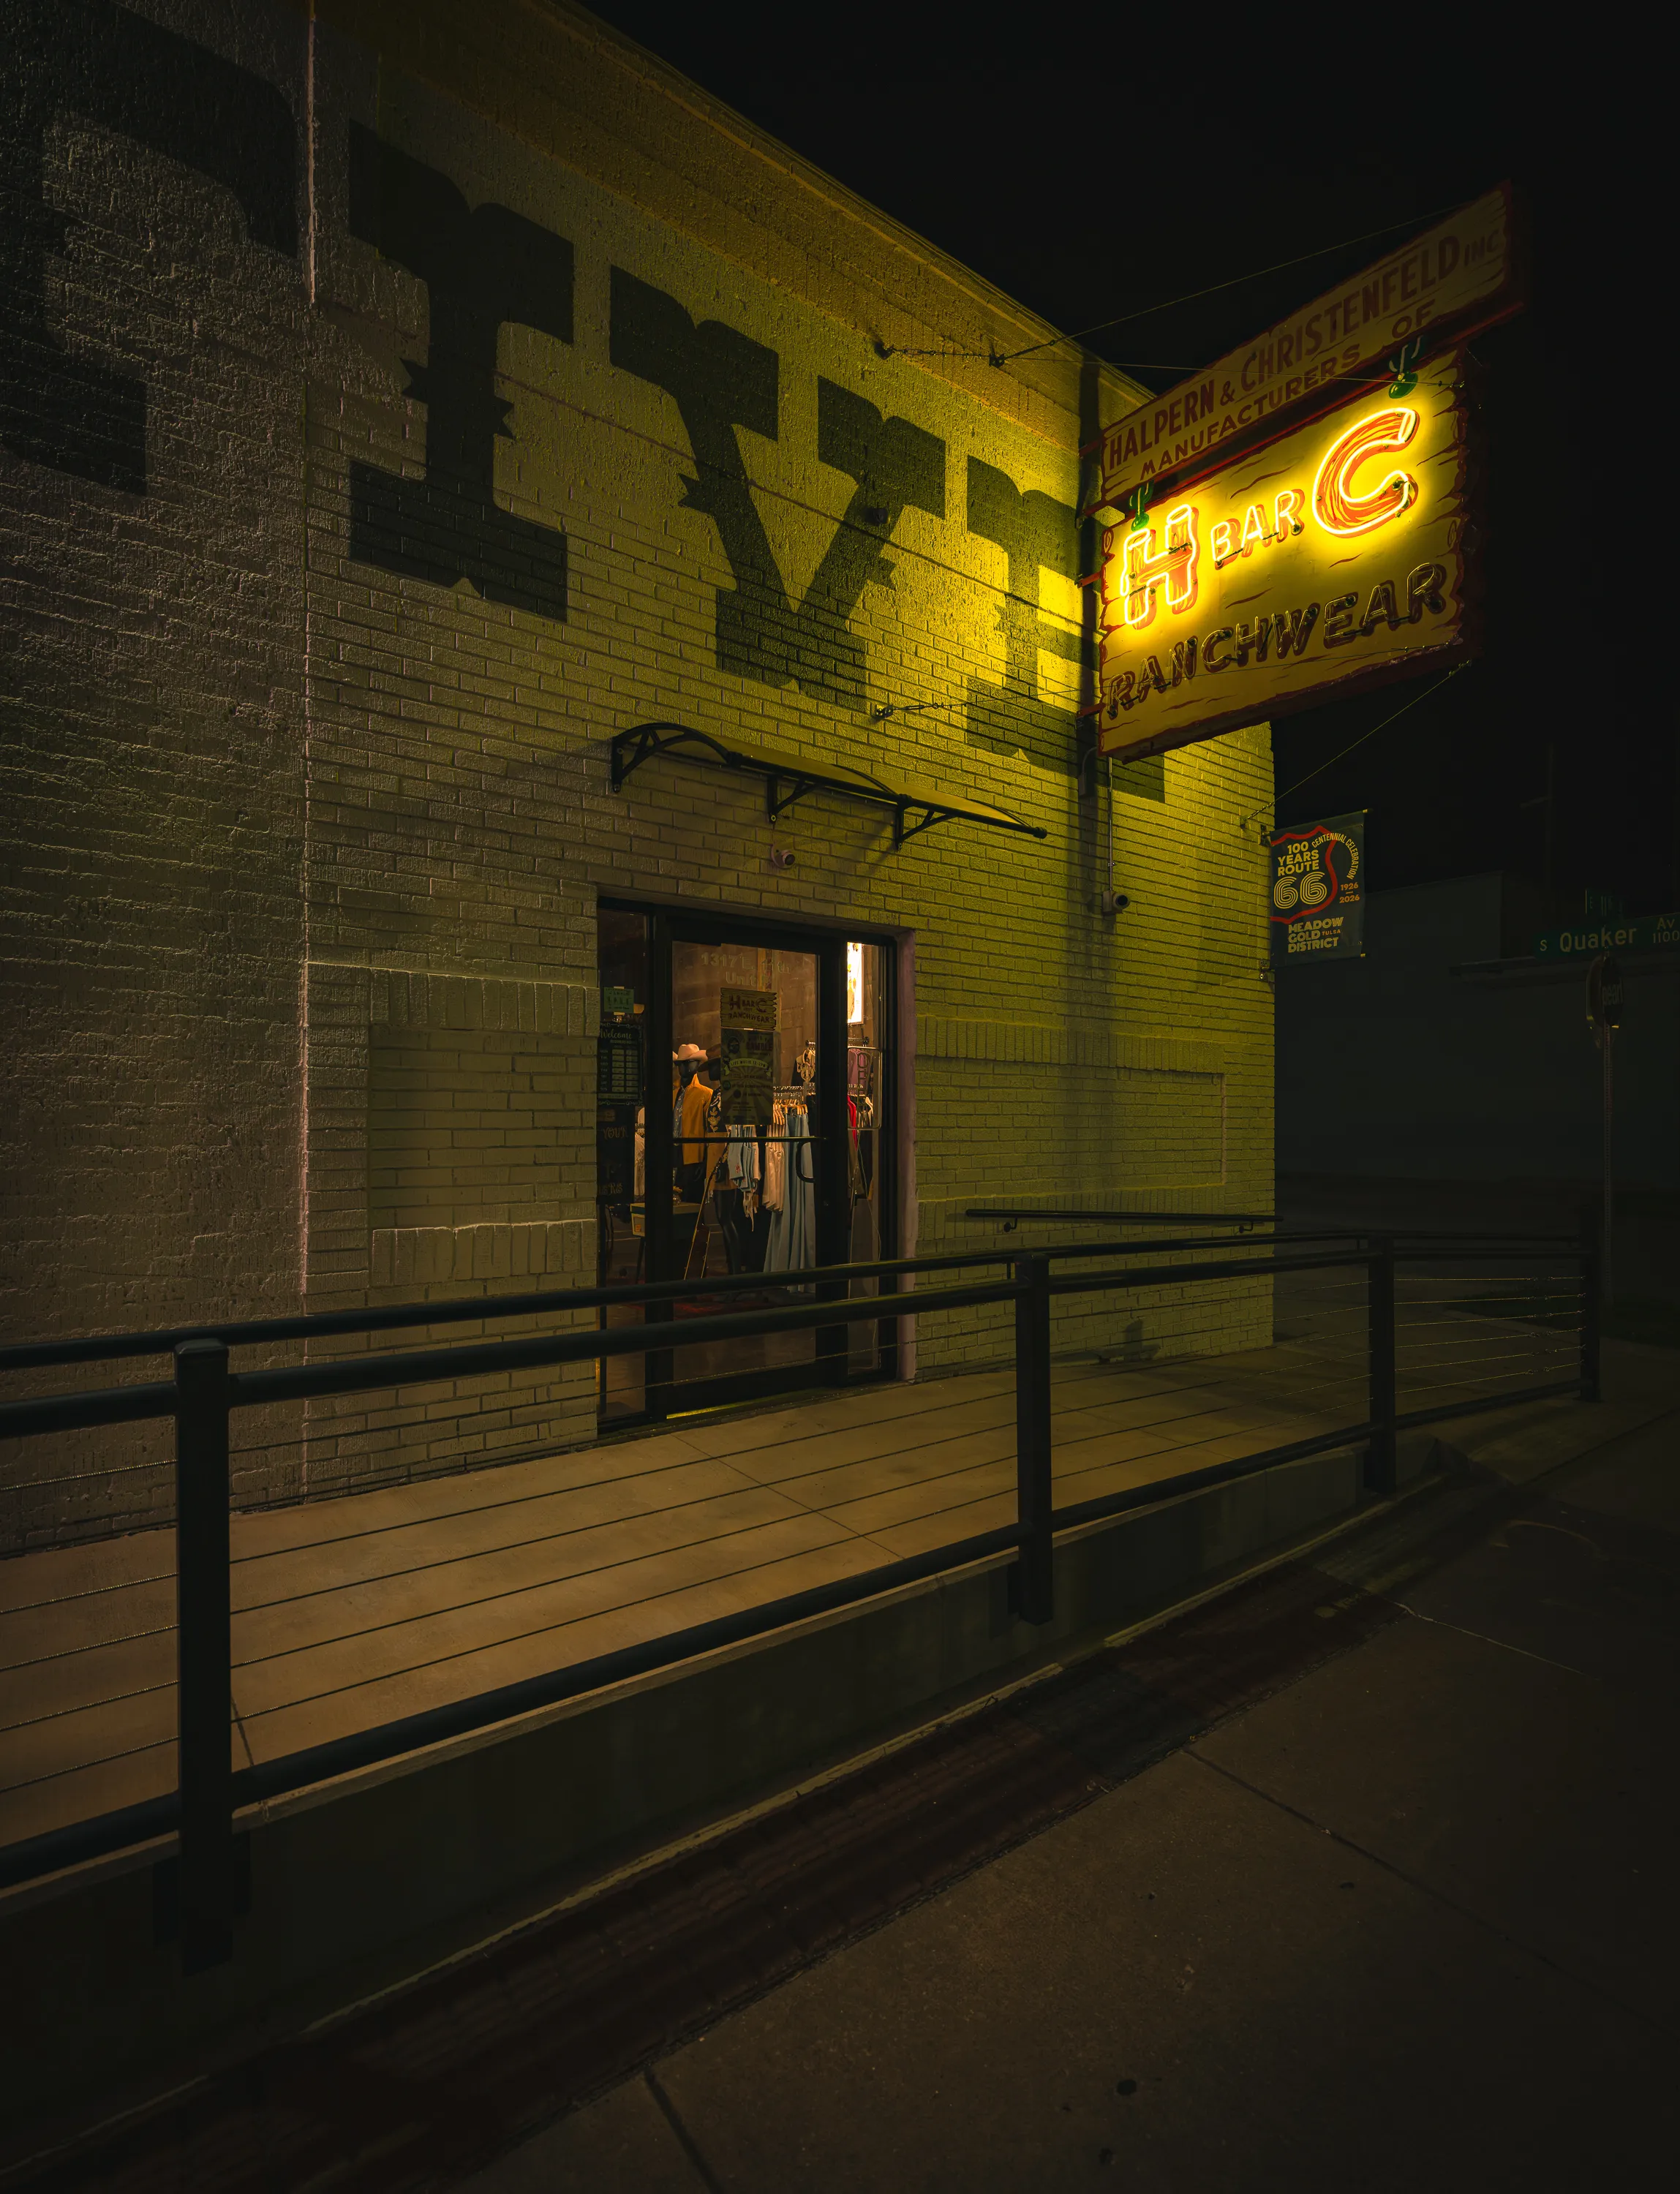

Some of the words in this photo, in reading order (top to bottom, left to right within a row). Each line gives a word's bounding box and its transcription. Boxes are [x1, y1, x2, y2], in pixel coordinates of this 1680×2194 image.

[1108, 379, 1215, 470] HALPERN
[1220, 382, 1235, 404] &
[1241, 235, 1461, 393] CHRISTENFELD
[1140, 343, 1360, 480] MANUFACTURERS
[1391, 300, 1436, 339] OF
[1120, 505, 1200, 630] H
[1210, 489, 1305, 570] BAR
[1311, 407, 1420, 539] C
[1105, 563, 1447, 719] RANCHWEAR
[1287, 841, 1309, 854] 100
[1311, 832, 1346, 848] CENTENNIAL
[1345, 838, 1360, 880] CELEBRATION
[1278, 849, 1319, 866] YEARS
[1278, 859, 1319, 877] ROUTE
[1273, 871, 1327, 909] 66
[1340, 882, 1359, 891] 1926
[1339, 894, 1360, 904] 2026
[1288, 916, 1344, 934] MEADOW
[1288, 930, 1321, 943] GOLD
[1559, 926, 1638, 953] Quaker
[1657, 917, 1676, 930] Av
[1652, 930, 1680, 944] 1100
[1288, 937, 1339, 953] DISTRICT
[701, 951, 738, 968] 1317
[726, 970, 757, 987] Unit
[728, 995, 741, 1010] H
[742, 999, 756, 1008] BAR
[756, 998, 767, 1013] C
[728, 1011, 769, 1022] RANCHWEAR
[600, 1028, 633, 1040] Welcome
[603, 1126, 628, 1141] YOUR
